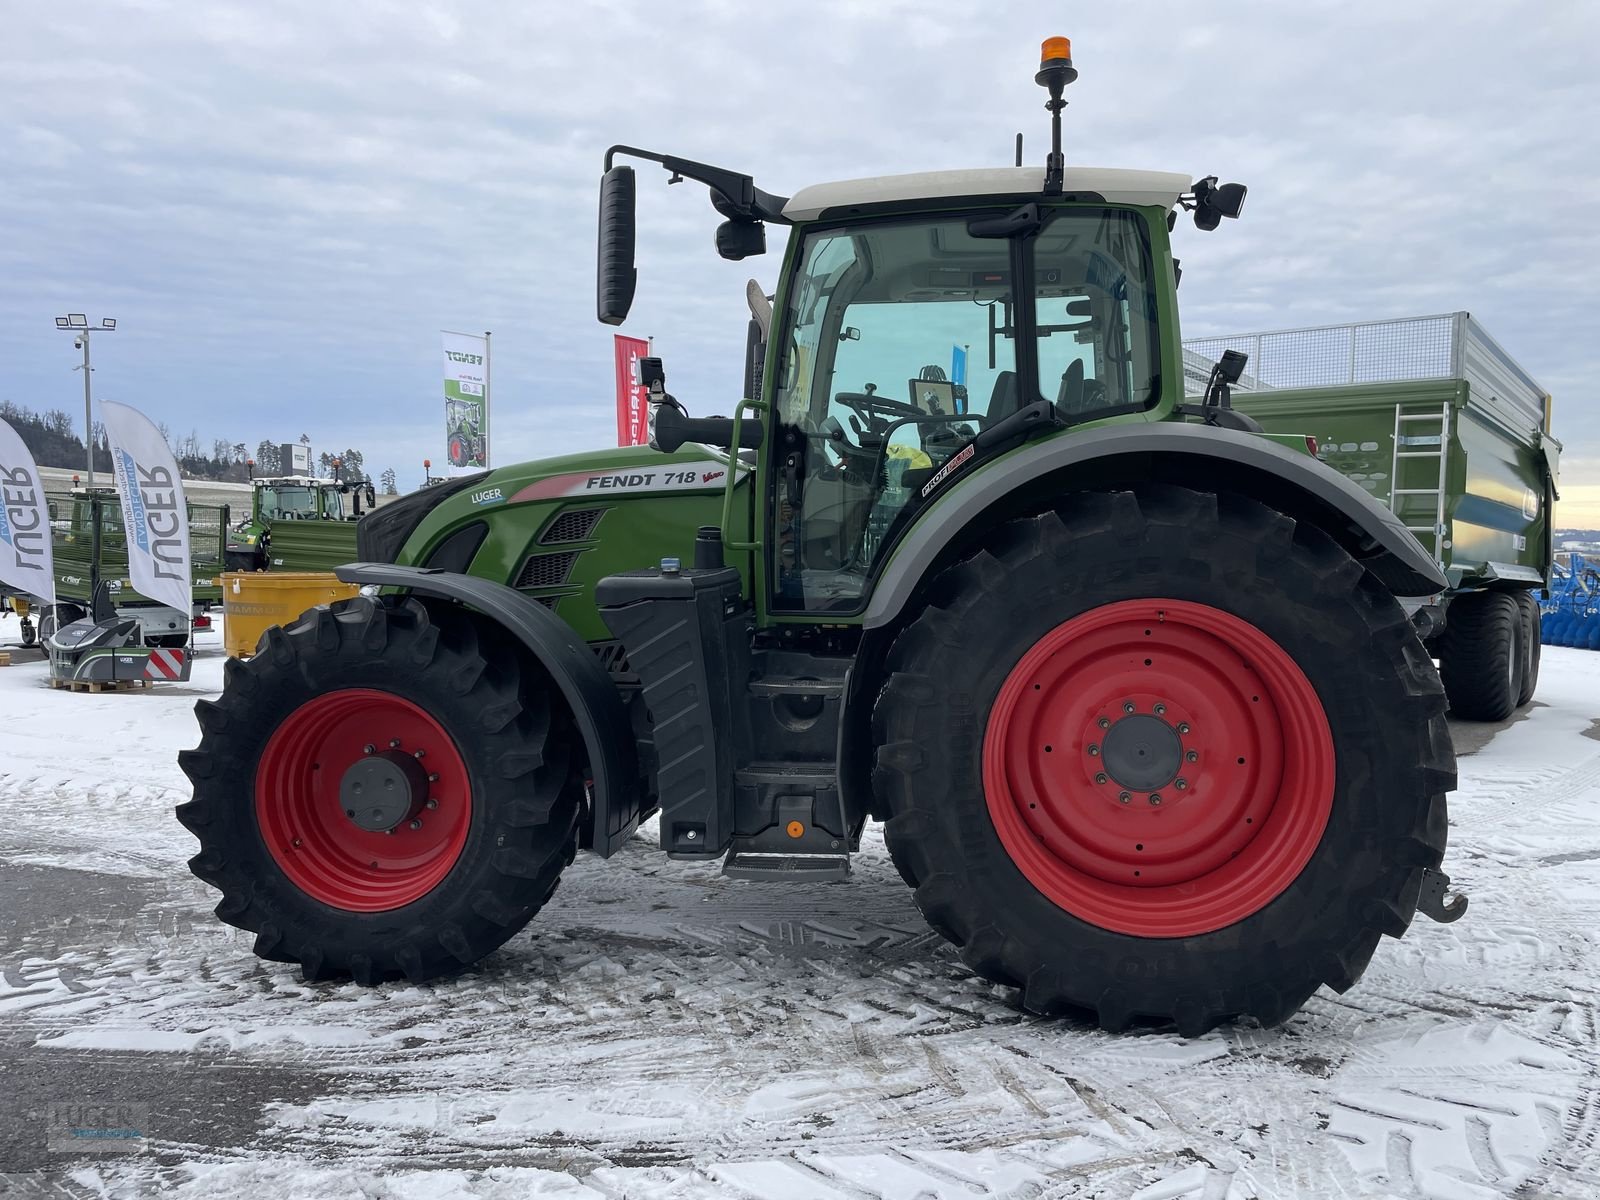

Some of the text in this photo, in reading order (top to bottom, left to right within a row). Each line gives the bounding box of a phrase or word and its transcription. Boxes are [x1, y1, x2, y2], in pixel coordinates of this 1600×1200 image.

[586, 474, 656, 489] FENDT
[664, 472, 696, 485] 718
[471, 488, 502, 504] LUGER
